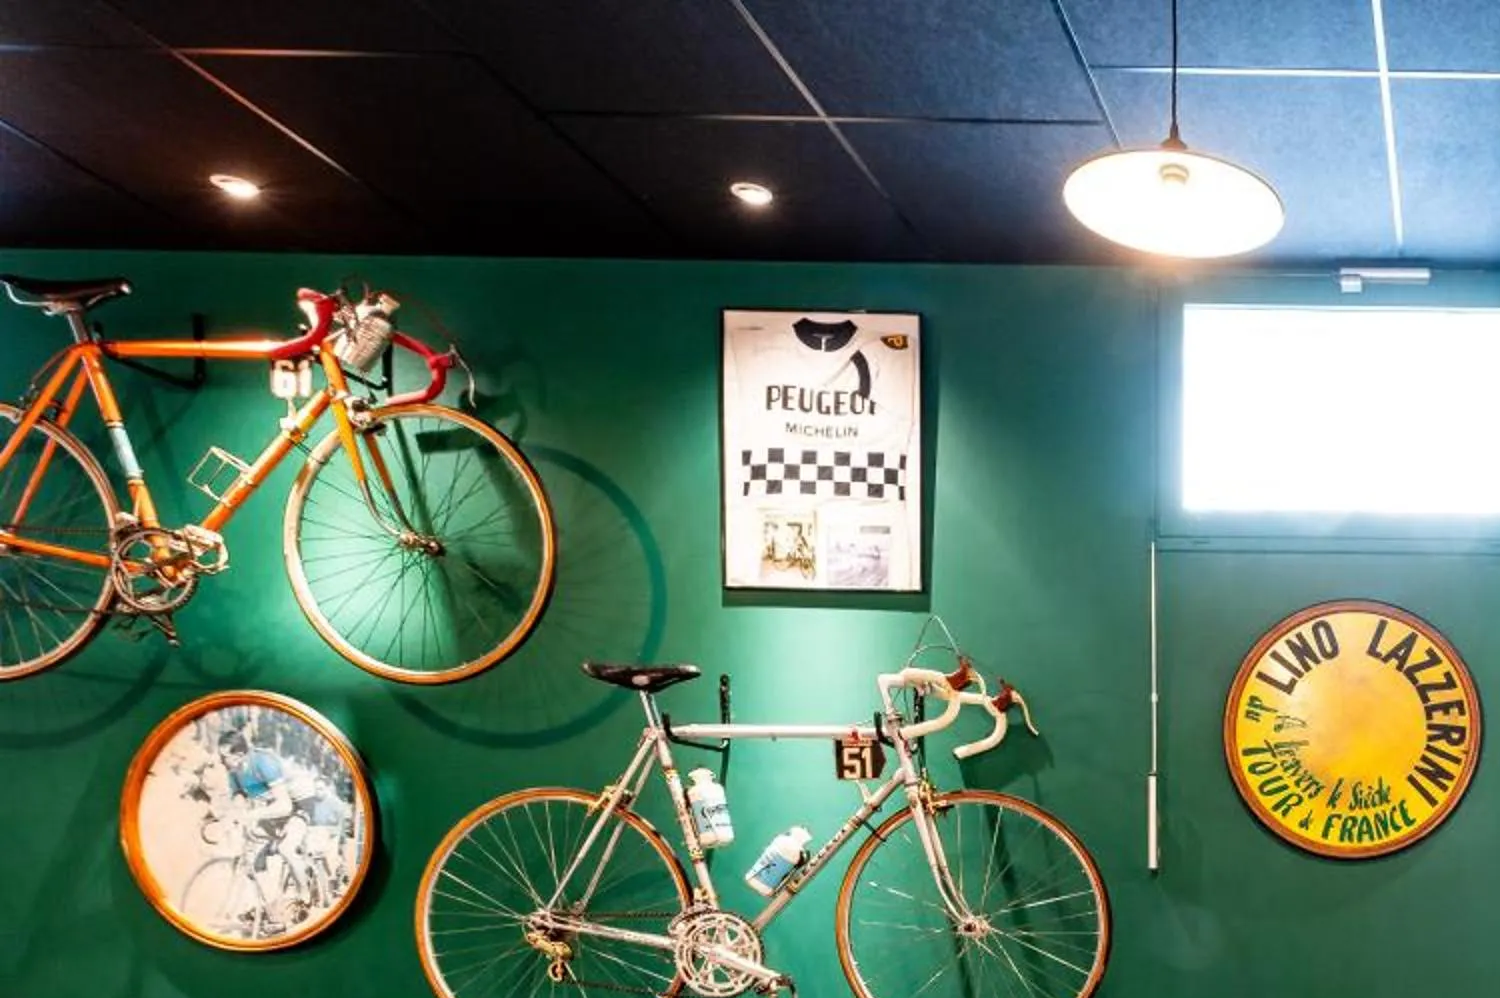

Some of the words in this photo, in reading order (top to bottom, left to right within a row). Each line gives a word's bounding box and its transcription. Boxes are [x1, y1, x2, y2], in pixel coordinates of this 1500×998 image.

[271, 360, 312, 397] 61
[785, 421, 859, 439] MICHELIN
[1256, 620, 1339, 695] LINO
[1366, 619, 1467, 808] LAZZERINI
[843, 747, 872, 778] 51
[1242, 740, 1304, 817] TOUR
[1321, 799, 1416, 842] FRANCE
